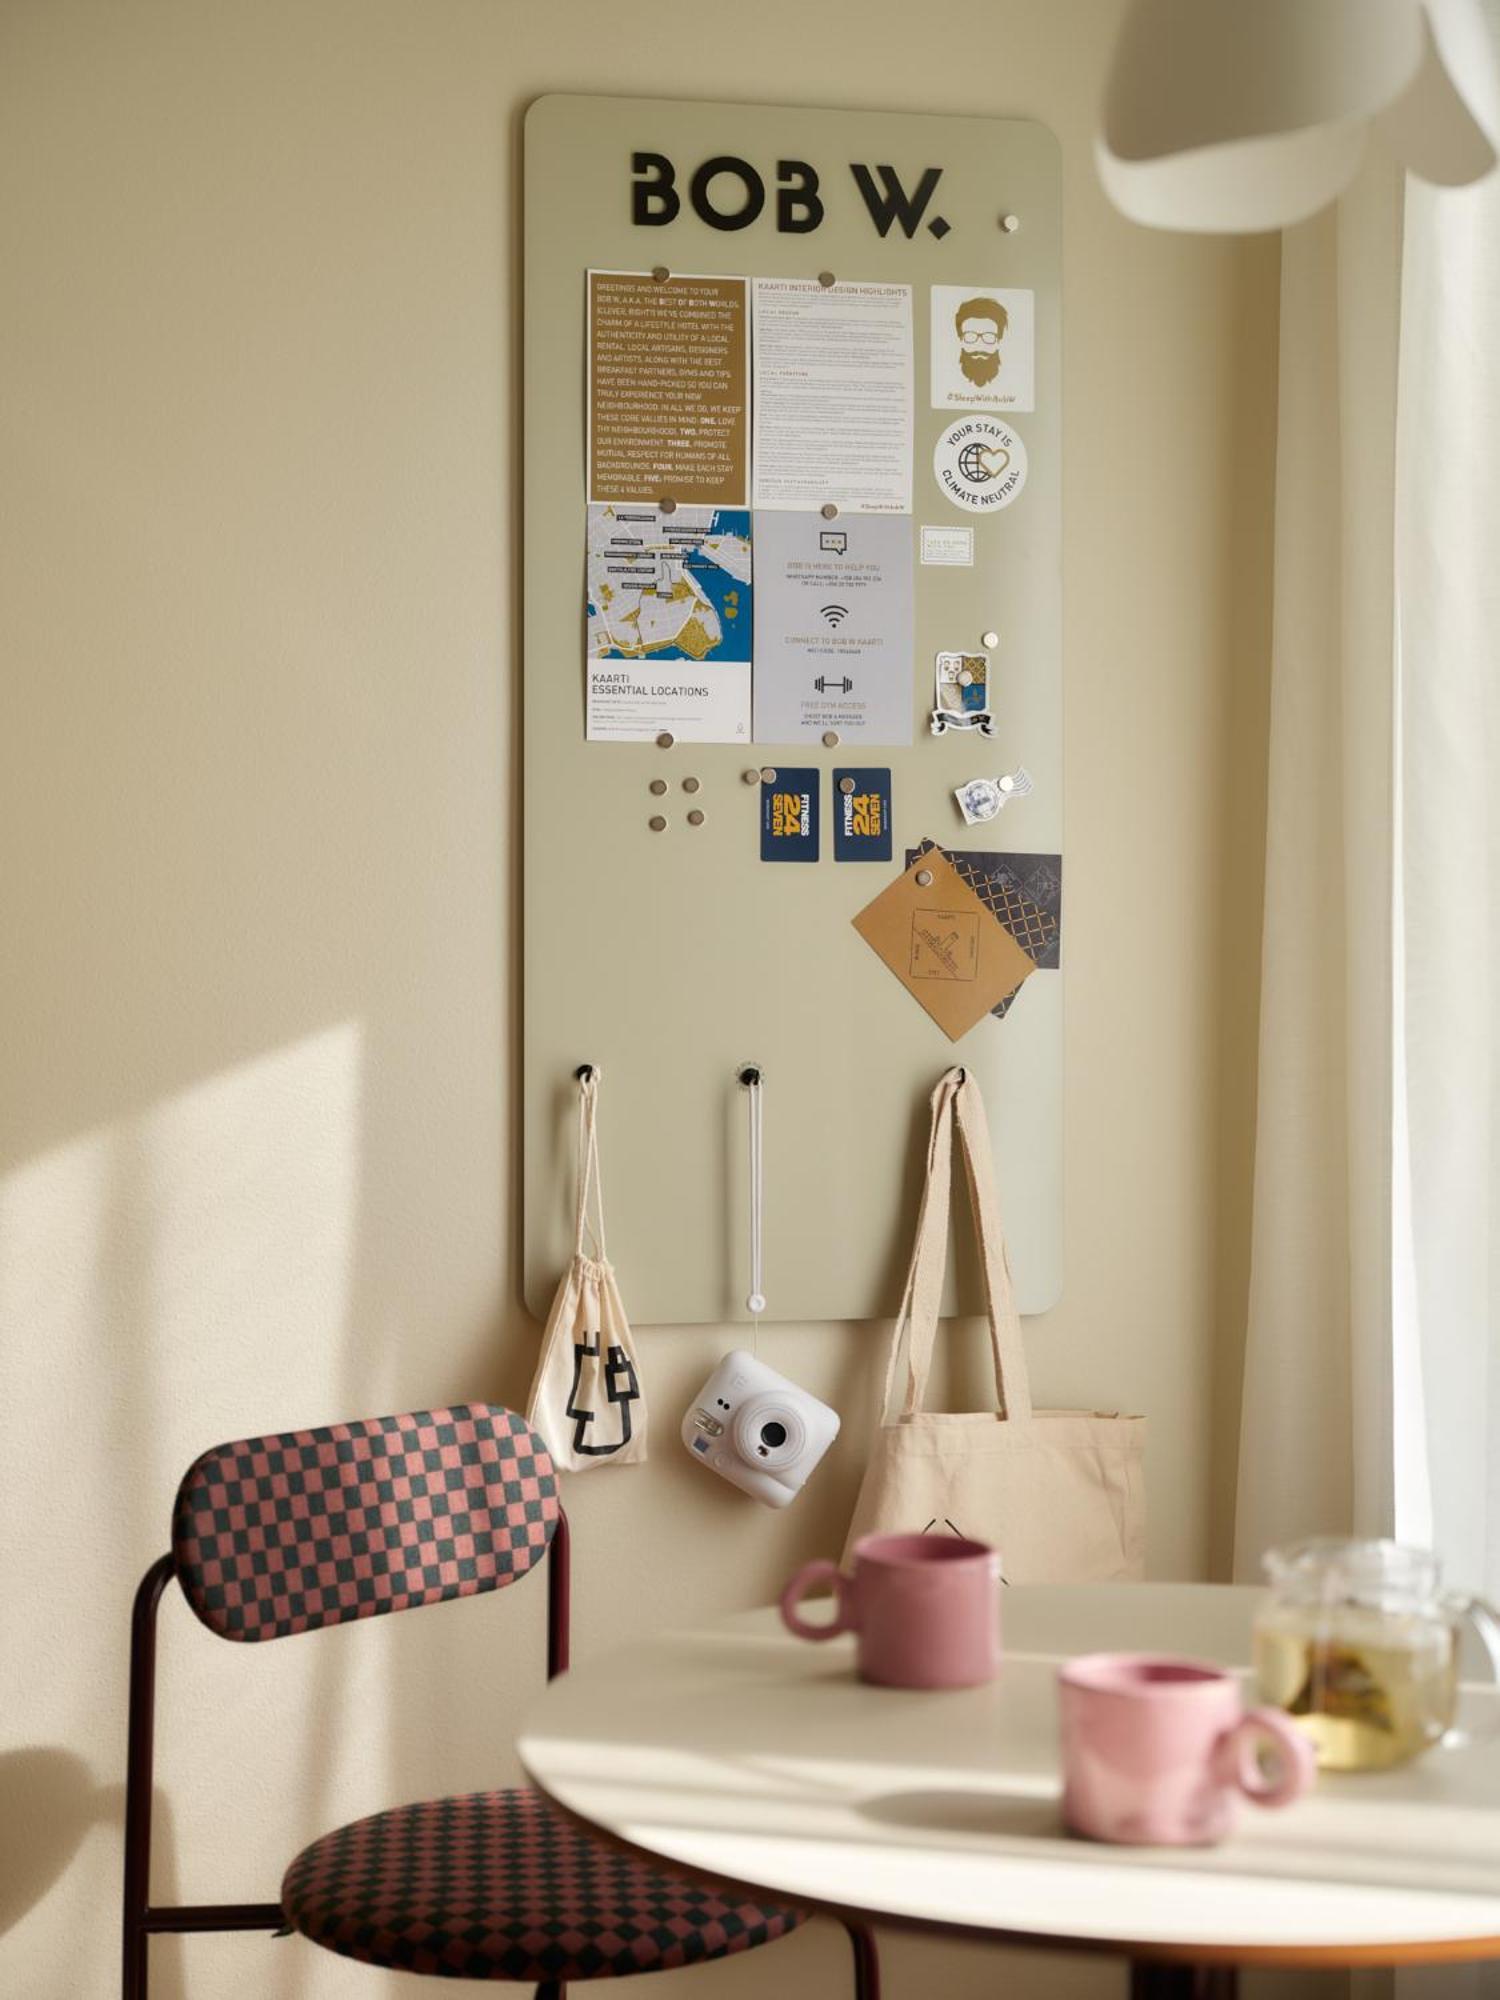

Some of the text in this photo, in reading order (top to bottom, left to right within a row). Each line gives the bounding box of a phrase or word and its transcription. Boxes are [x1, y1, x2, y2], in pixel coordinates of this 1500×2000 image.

[631, 152, 951, 240] BOB W.
[946, 423, 1012, 448] YOUR STAY IS
[942, 469, 978, 505] CLIMATE
[981, 470, 1020, 505] NEUTRAL
[592, 674, 630, 684] KAARTI
[592, 685, 709, 696] ESSENTIAL LOCATIONS
[772, 794, 784, 836] SEVEN
[784, 794, 800, 835] 24
[800, 794, 810, 836] FITNESS
[844, 794, 853, 836] FITNESS
[852, 794, 870, 836] 24
[870, 794, 880, 836] SEVEN
